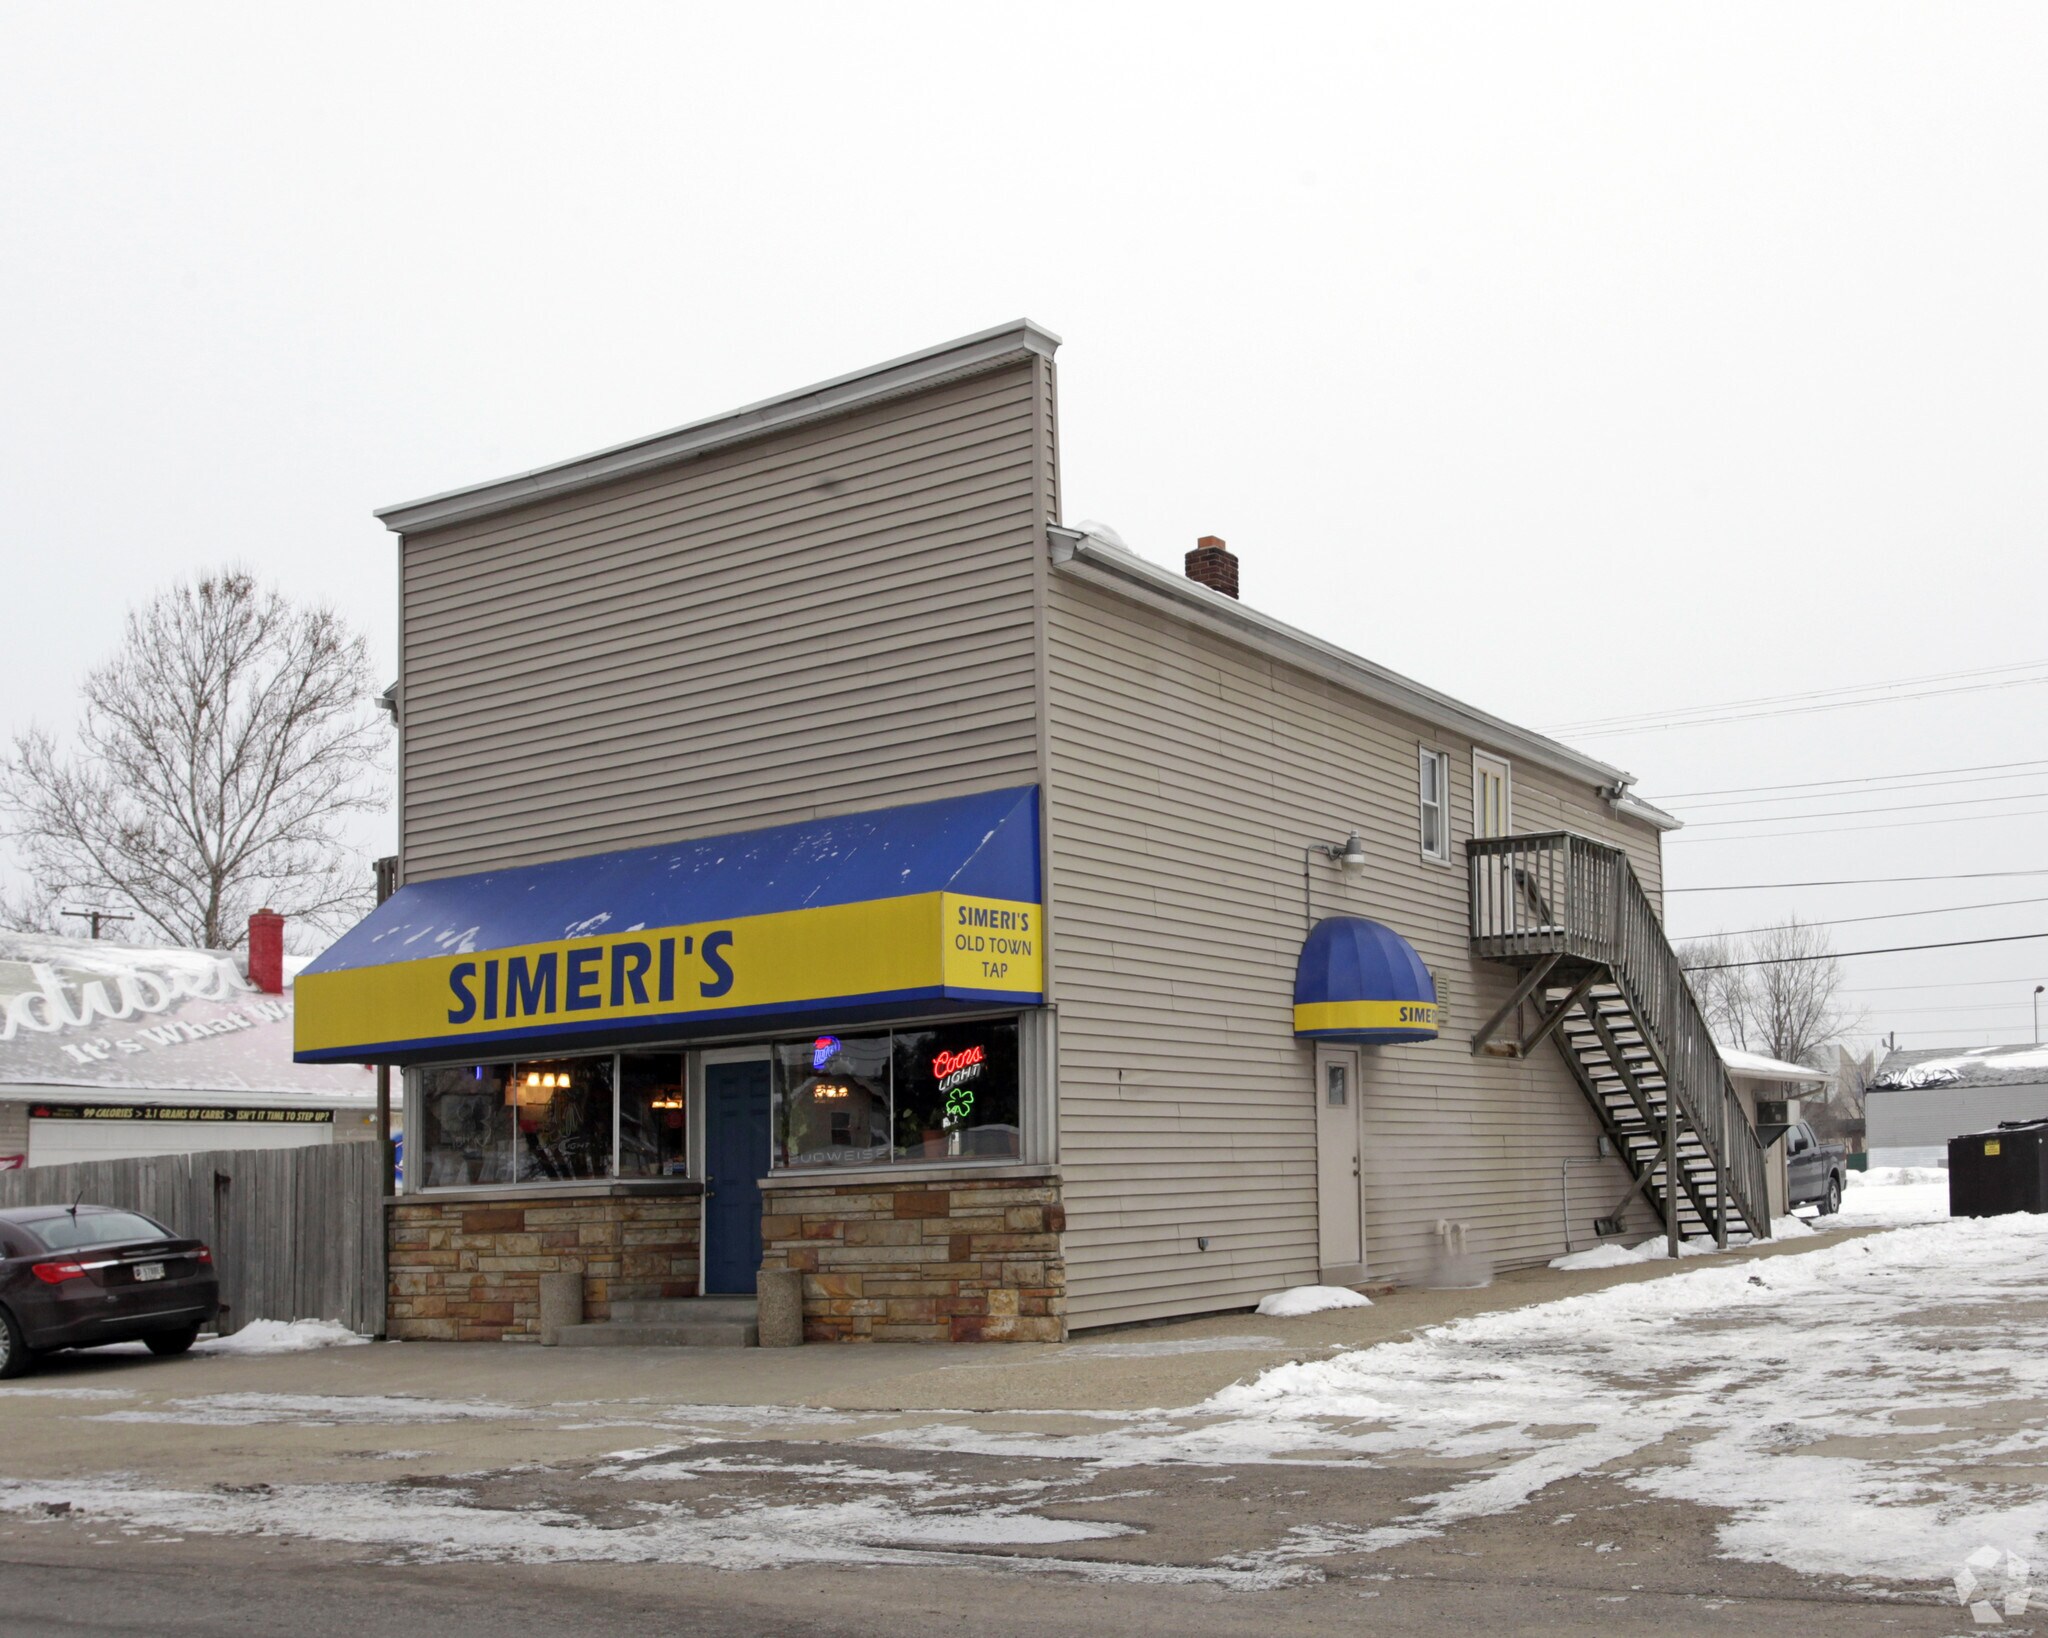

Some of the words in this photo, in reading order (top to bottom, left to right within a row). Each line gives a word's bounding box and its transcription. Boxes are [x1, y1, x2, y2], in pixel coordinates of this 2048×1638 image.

[959, 905, 1029, 932] SIMERI'S
[955, 934, 985, 952] OLD
[989, 937, 1032, 956] TOWN
[447, 930, 734, 1025] SIMERI'S
[982, 961, 1008, 978] TAP
[61, 1037, 144, 1065] It's
[136, 1010, 257, 1047] What
[931, 1045, 983, 1079] Coors
[938, 1063, 981, 1091] LIGHT
[83, 1108, 94, 1118] 99
[95, 1108, 133, 1118] CALORIES
[144, 1109, 157, 1118] 3.1
[159, 1109, 187, 1119] GRAMS
[189, 1109, 199, 1119] OF
[200, 1109, 225, 1119] CARBS
[236, 1110, 256, 1120] ISN'T
[257, 1111, 265, 1120] IT
[266, 1111, 284, 1120] TIME
[285, 1111, 295, 1120] TO
[296, 1111, 314, 1121] STEP
[314, 1112, 330, 1121] UP?
